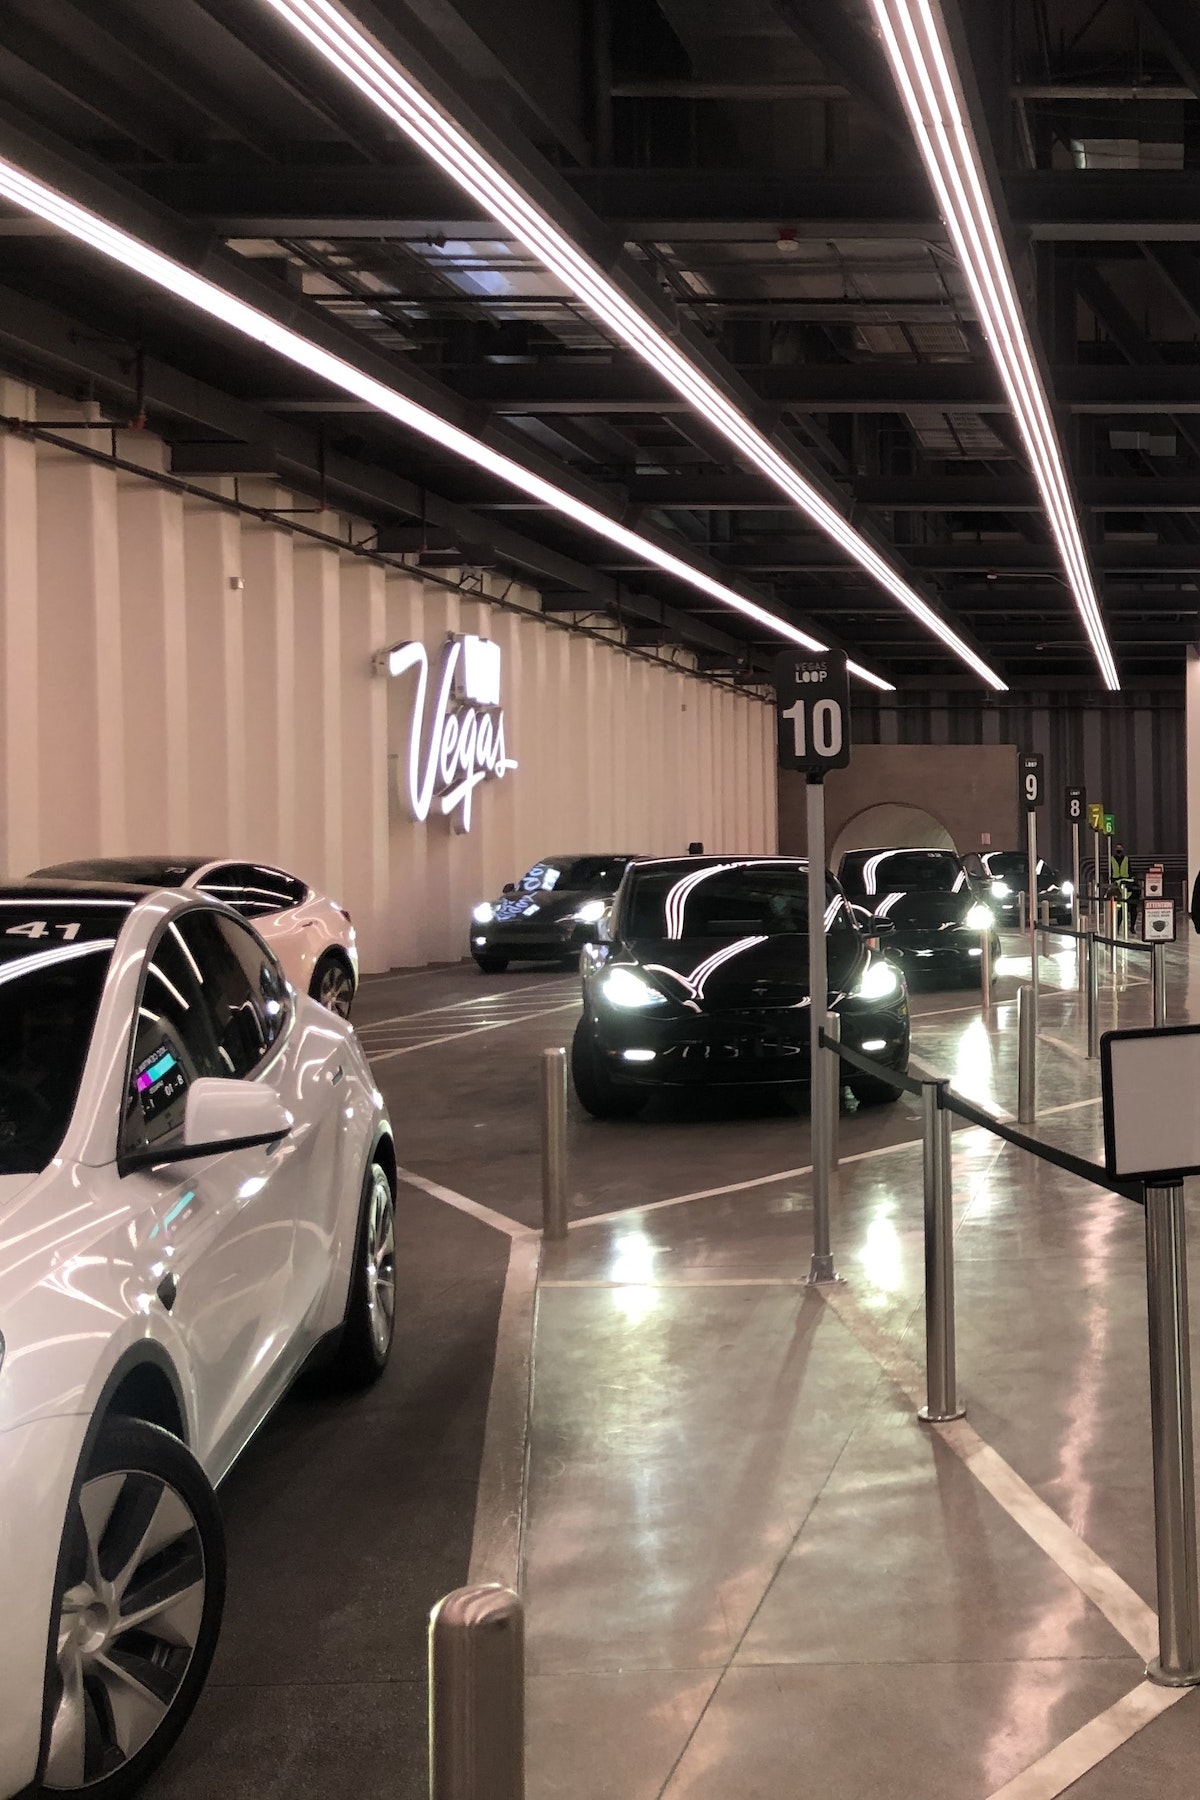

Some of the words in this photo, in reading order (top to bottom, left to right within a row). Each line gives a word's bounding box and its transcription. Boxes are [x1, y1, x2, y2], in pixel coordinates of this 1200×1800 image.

[795, 671, 828, 683] LOOP
[389, 640, 519, 833] Vegas
[782, 699, 842, 757] 10
[1025, 774, 1038, 801] 9
[1070, 799, 1081, 817] 8
[1092, 814, 1100, 828] 7
[1106, 822, 1112, 833] 6
[5, 921, 82, 940] 41
